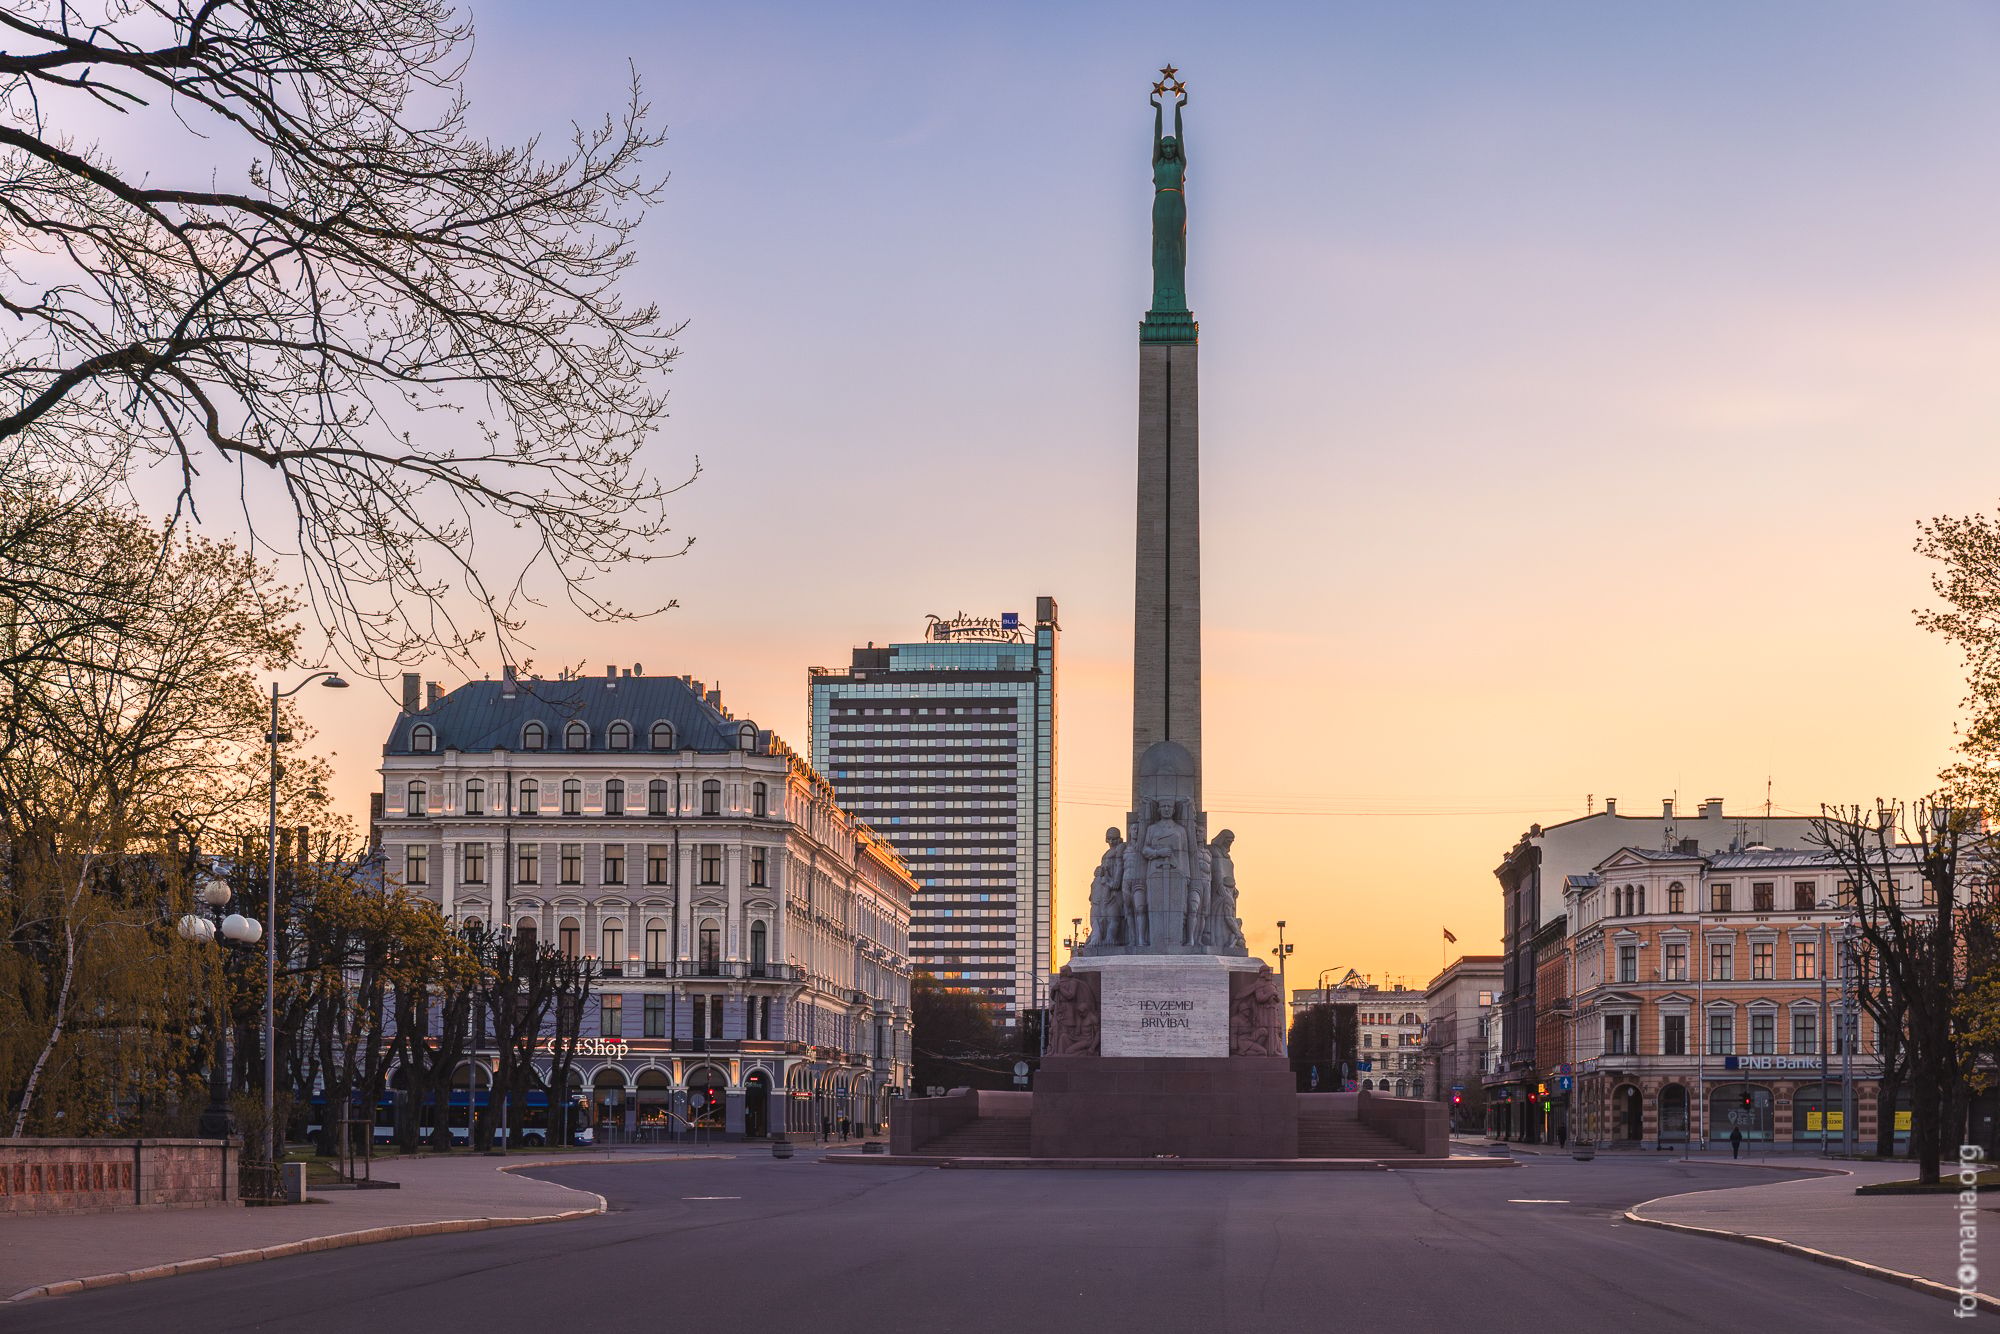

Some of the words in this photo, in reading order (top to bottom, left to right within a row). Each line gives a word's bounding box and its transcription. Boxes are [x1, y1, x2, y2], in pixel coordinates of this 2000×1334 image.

[547, 1038, 628, 1061] GitShop
[1738, 1056, 1772, 1070] PNB
[1776, 1056, 1822, 1070] Banka
